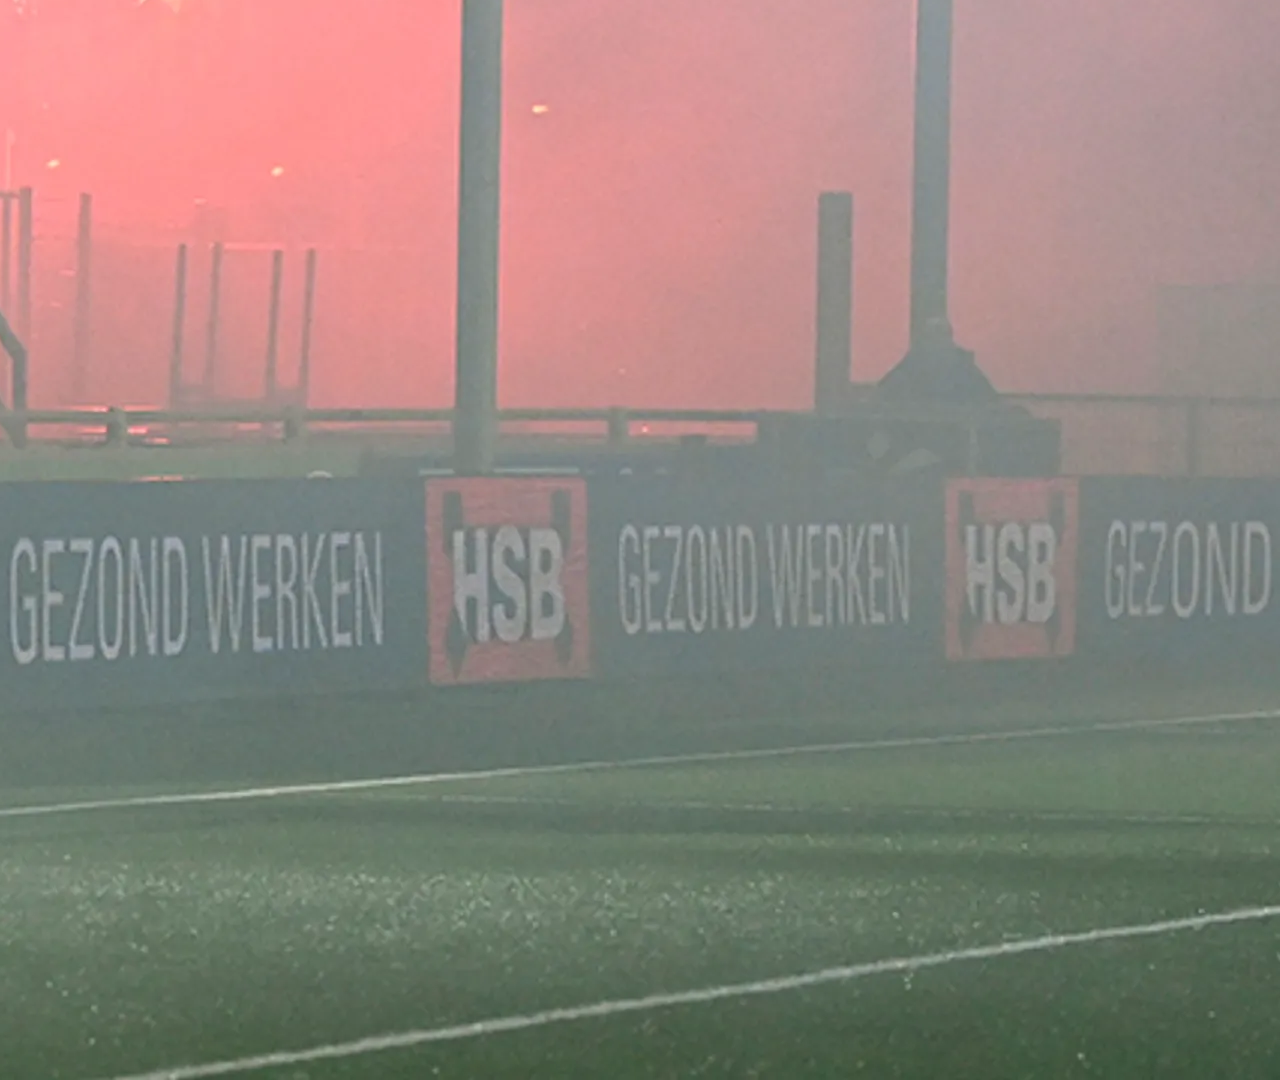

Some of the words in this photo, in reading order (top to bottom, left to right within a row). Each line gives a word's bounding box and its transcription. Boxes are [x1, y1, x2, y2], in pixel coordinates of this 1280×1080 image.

[9, 535, 189, 665] GEZOND
[201, 530, 385, 654] WERKEN
[452, 525, 567, 643] HSB
[620, 523, 759, 636] GEZOND
[765, 522, 911, 629] WERKEN
[966, 522, 1057, 625] HSB
[1105, 520, 1273, 620] GEZOND
